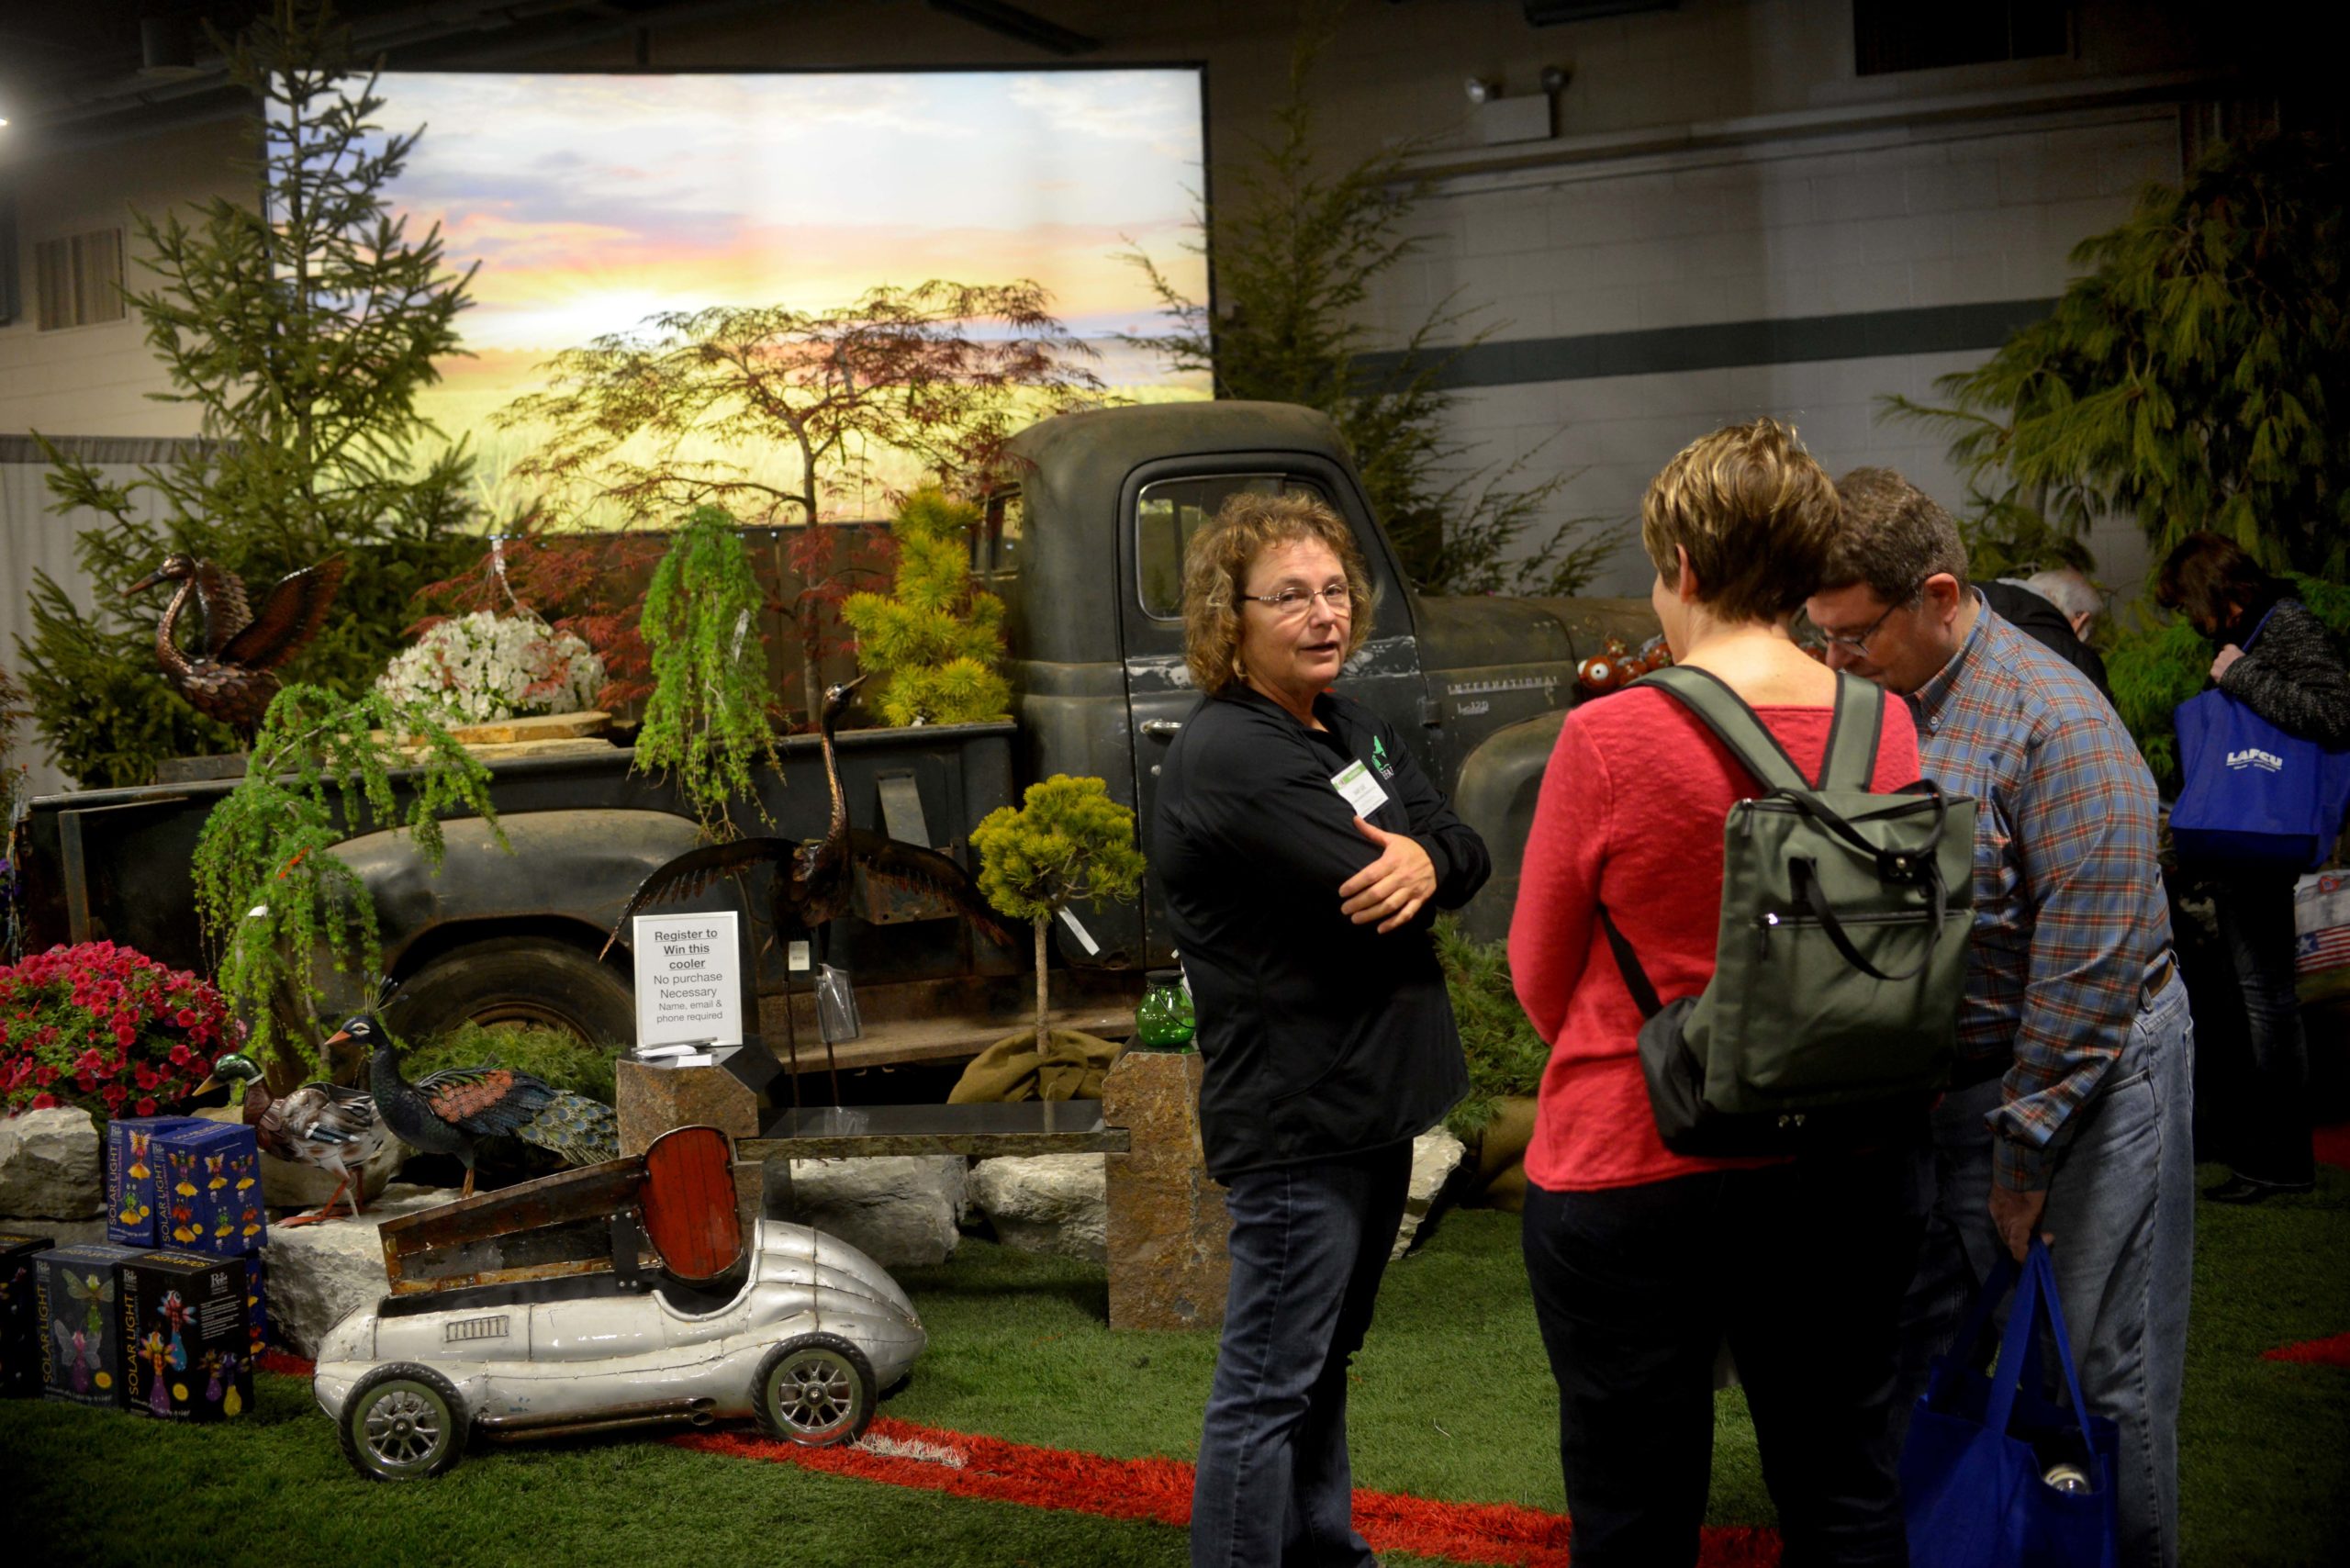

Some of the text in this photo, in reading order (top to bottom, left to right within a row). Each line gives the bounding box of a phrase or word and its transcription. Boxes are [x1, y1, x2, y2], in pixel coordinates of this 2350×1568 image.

[2226, 747, 2283, 767] LAFCU
[655, 929, 718, 942] Register to
[664, 944, 710, 955] Win this
[669, 958, 706, 969] cooler
[654, 973, 723, 986] No purchase
[660, 988, 718, 999] Necessary
[656, 1012, 723, 1024] phone required
[690, 1001, 713, 1009] email
[109, 1145, 118, 1182] LIGHT
[153, 1162, 165, 1199] LIGHT
[108, 1185, 118, 1226] SOLAR
[159, 1202, 171, 1242] SOLAR
[37, 1282, 49, 1329] LIGHT
[124, 1293, 137, 1340] LIGHT
[40, 1332, 52, 1383] SOLAR
[127, 1344, 139, 1395] SOLAR
